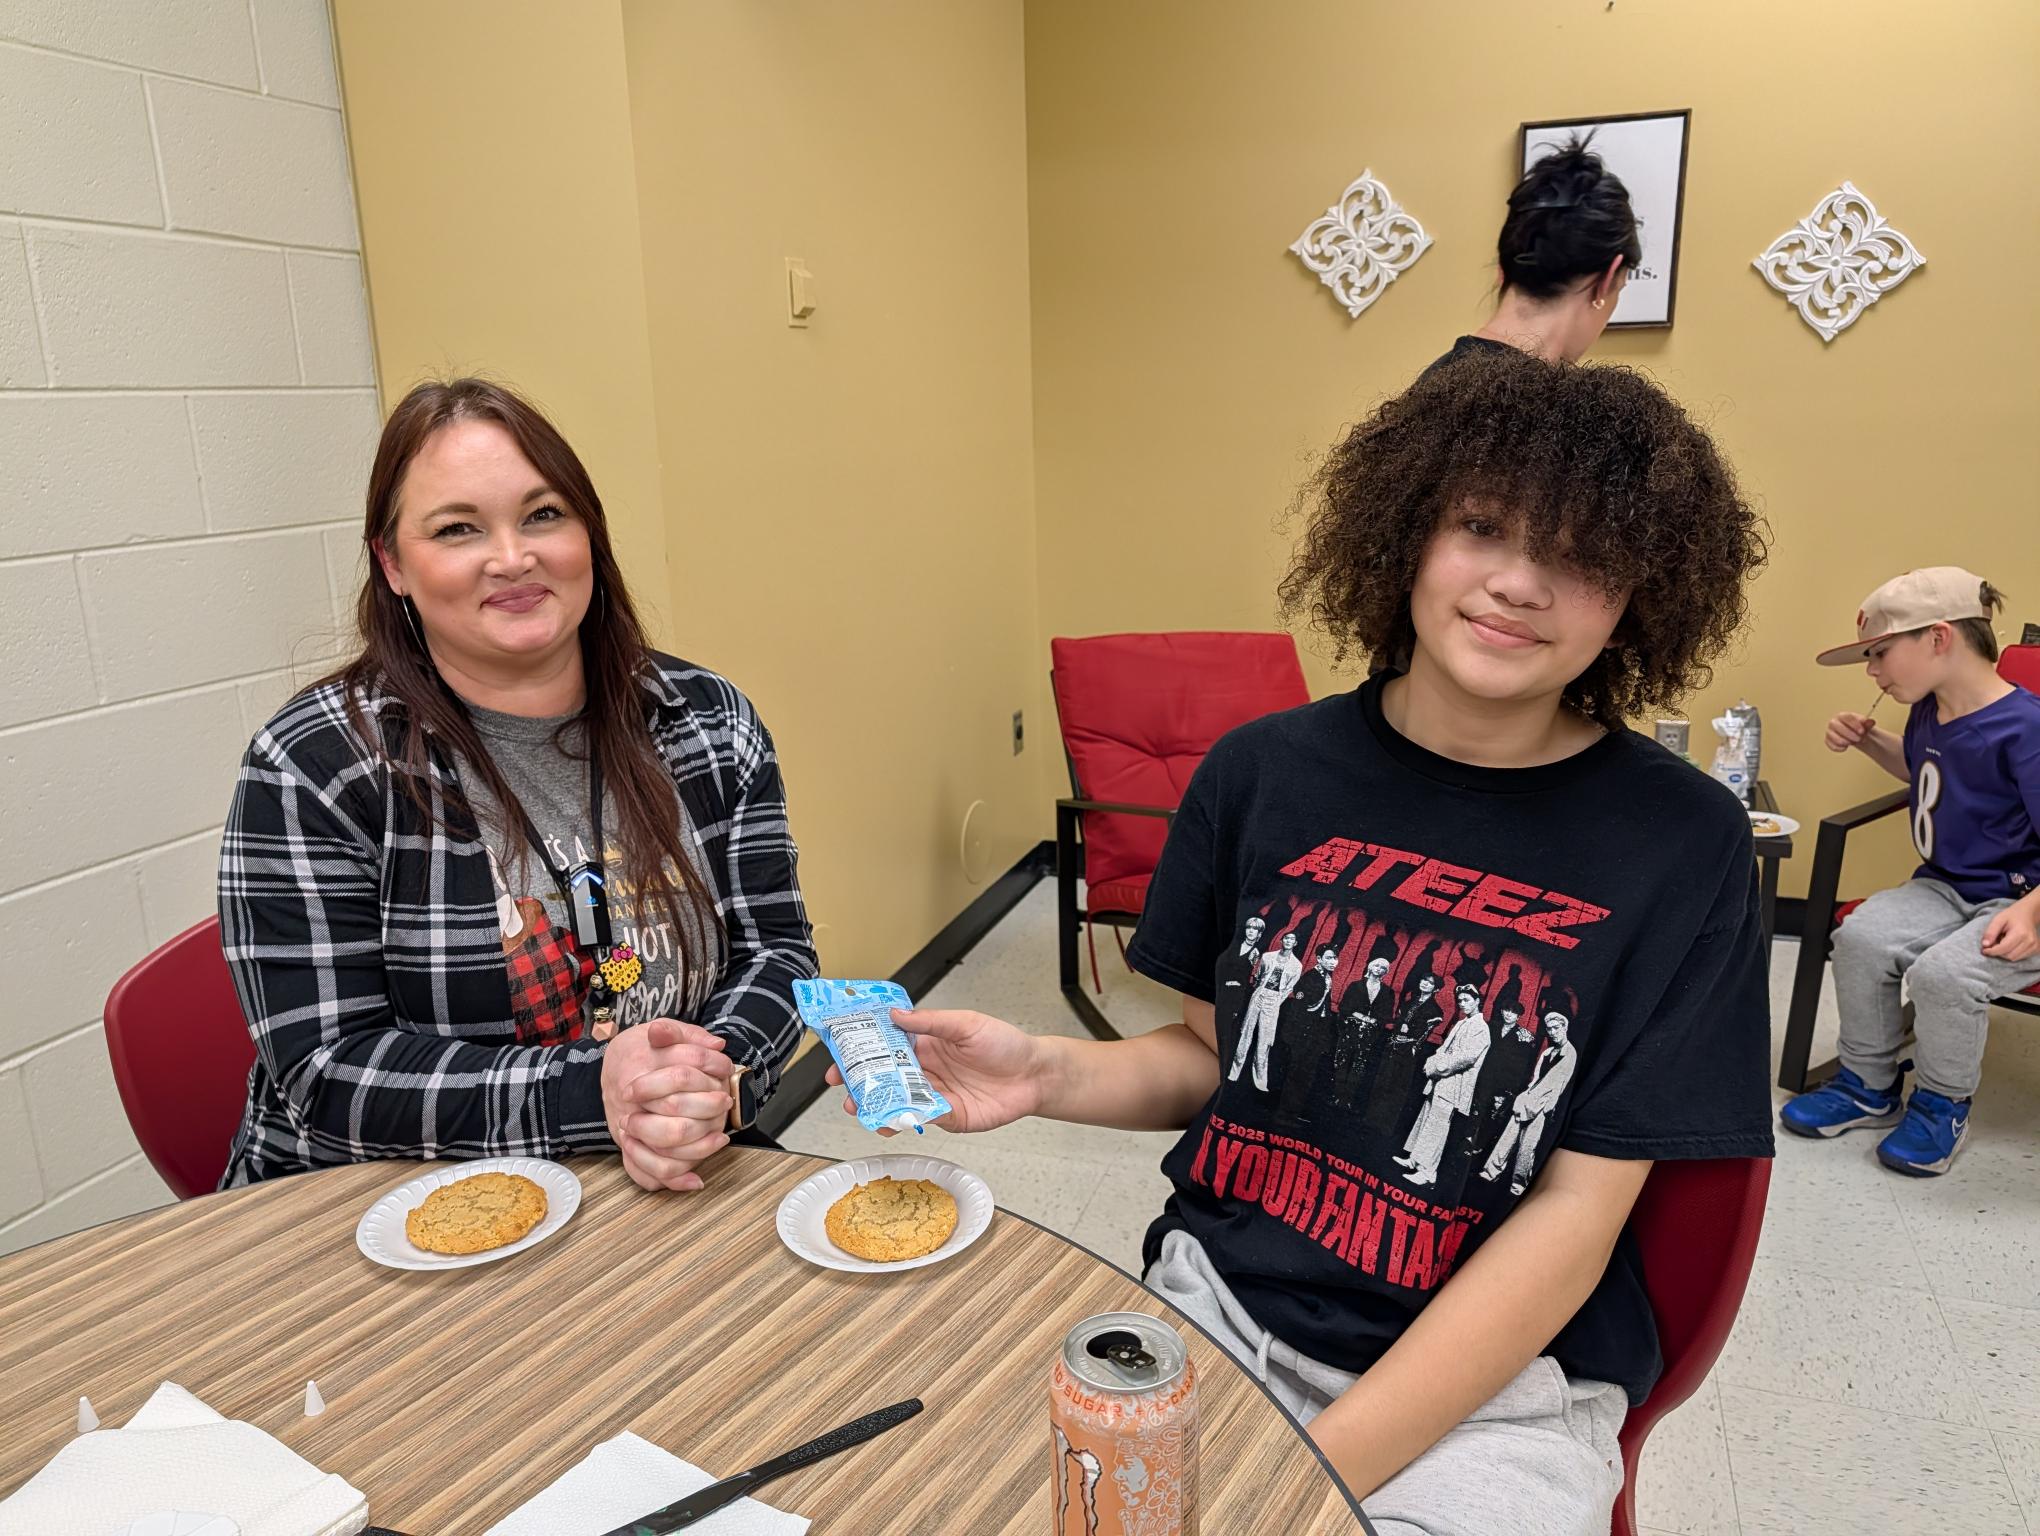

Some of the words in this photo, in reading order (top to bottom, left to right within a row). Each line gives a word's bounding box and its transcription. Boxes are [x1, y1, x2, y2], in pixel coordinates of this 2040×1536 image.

[1914, 761, 1941, 861] 8
[1278, 836, 1612, 950] ATEEZ
[831, 1026, 858, 1038] Calories
[1212, 1135, 1323, 1233] YOUR
[1228, 1123, 1265, 1142] 2025
[1269, 1133, 1322, 1160] WORLD
[1326, 1153, 1363, 1180] TOUR
[1364, 1173, 1380, 1189] IN
[1382, 1182, 1429, 1214] YOUR
[1063, 1384, 1121, 1417] SUGAR
